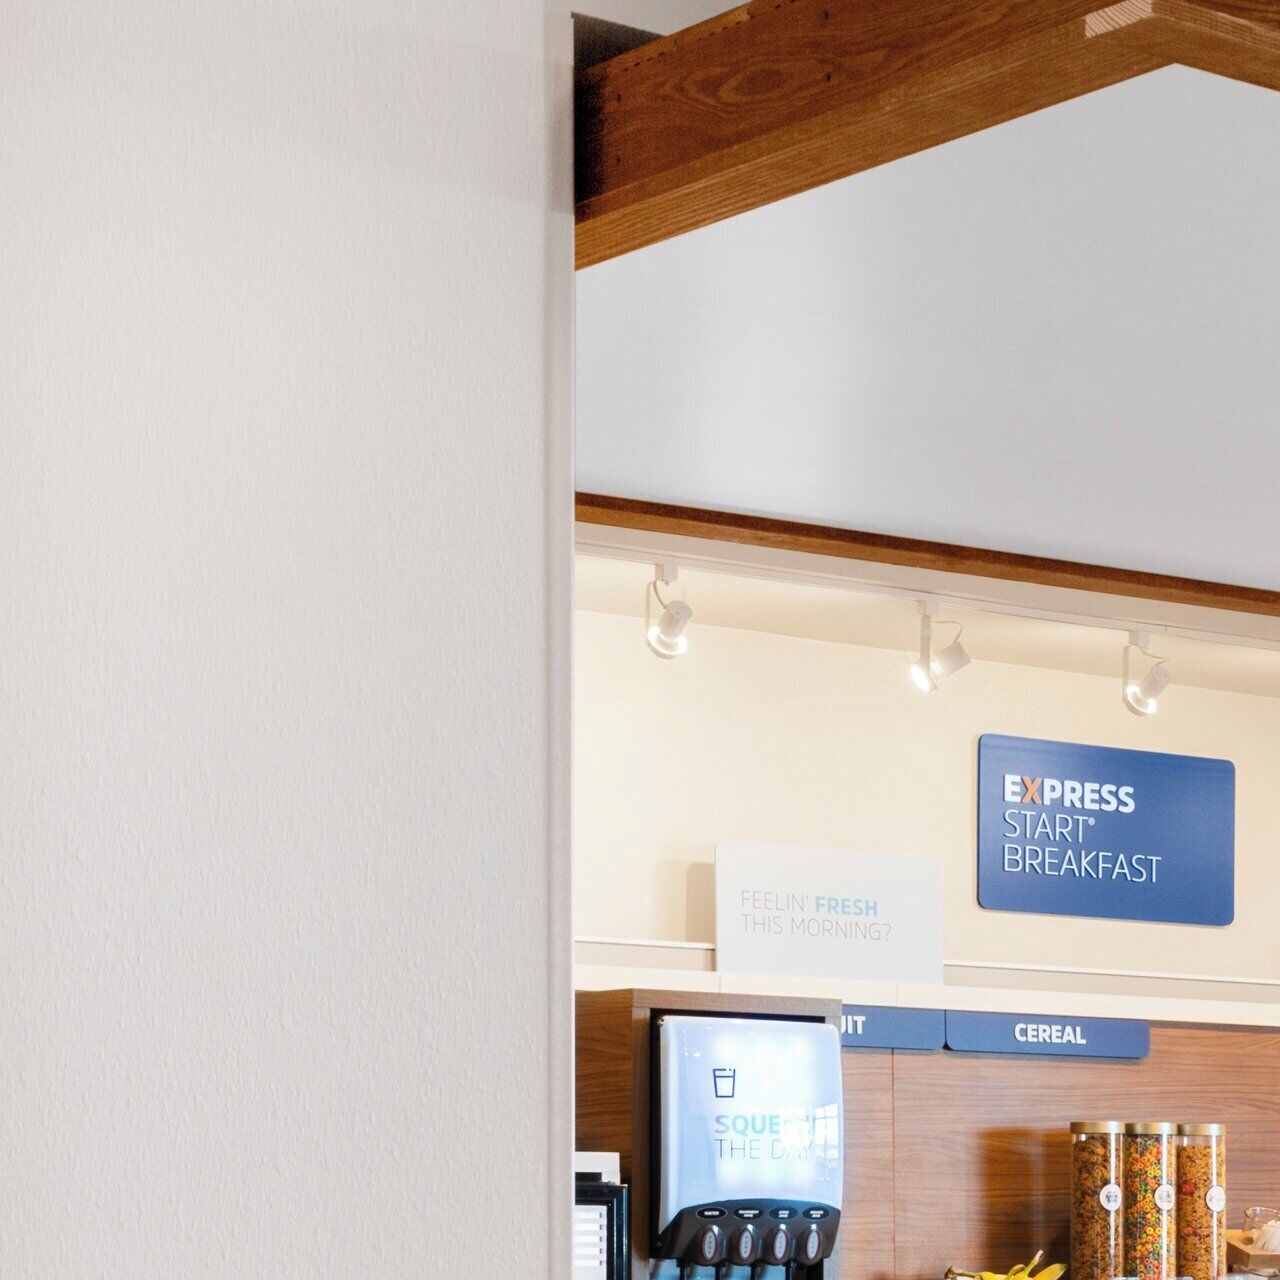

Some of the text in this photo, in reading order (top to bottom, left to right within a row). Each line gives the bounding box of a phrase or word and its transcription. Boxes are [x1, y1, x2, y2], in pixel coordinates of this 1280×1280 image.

[1003, 773, 1136, 814] EXPRESS
[1003, 843, 1163, 884] BREAKFAST
[740, 889, 879, 918] FEELIN' FRESH
[741, 913, 893, 942] THIS MORNING?
[1014, 1022, 1087, 1045] CEREAL
[714, 1138, 761, 1161] THE
